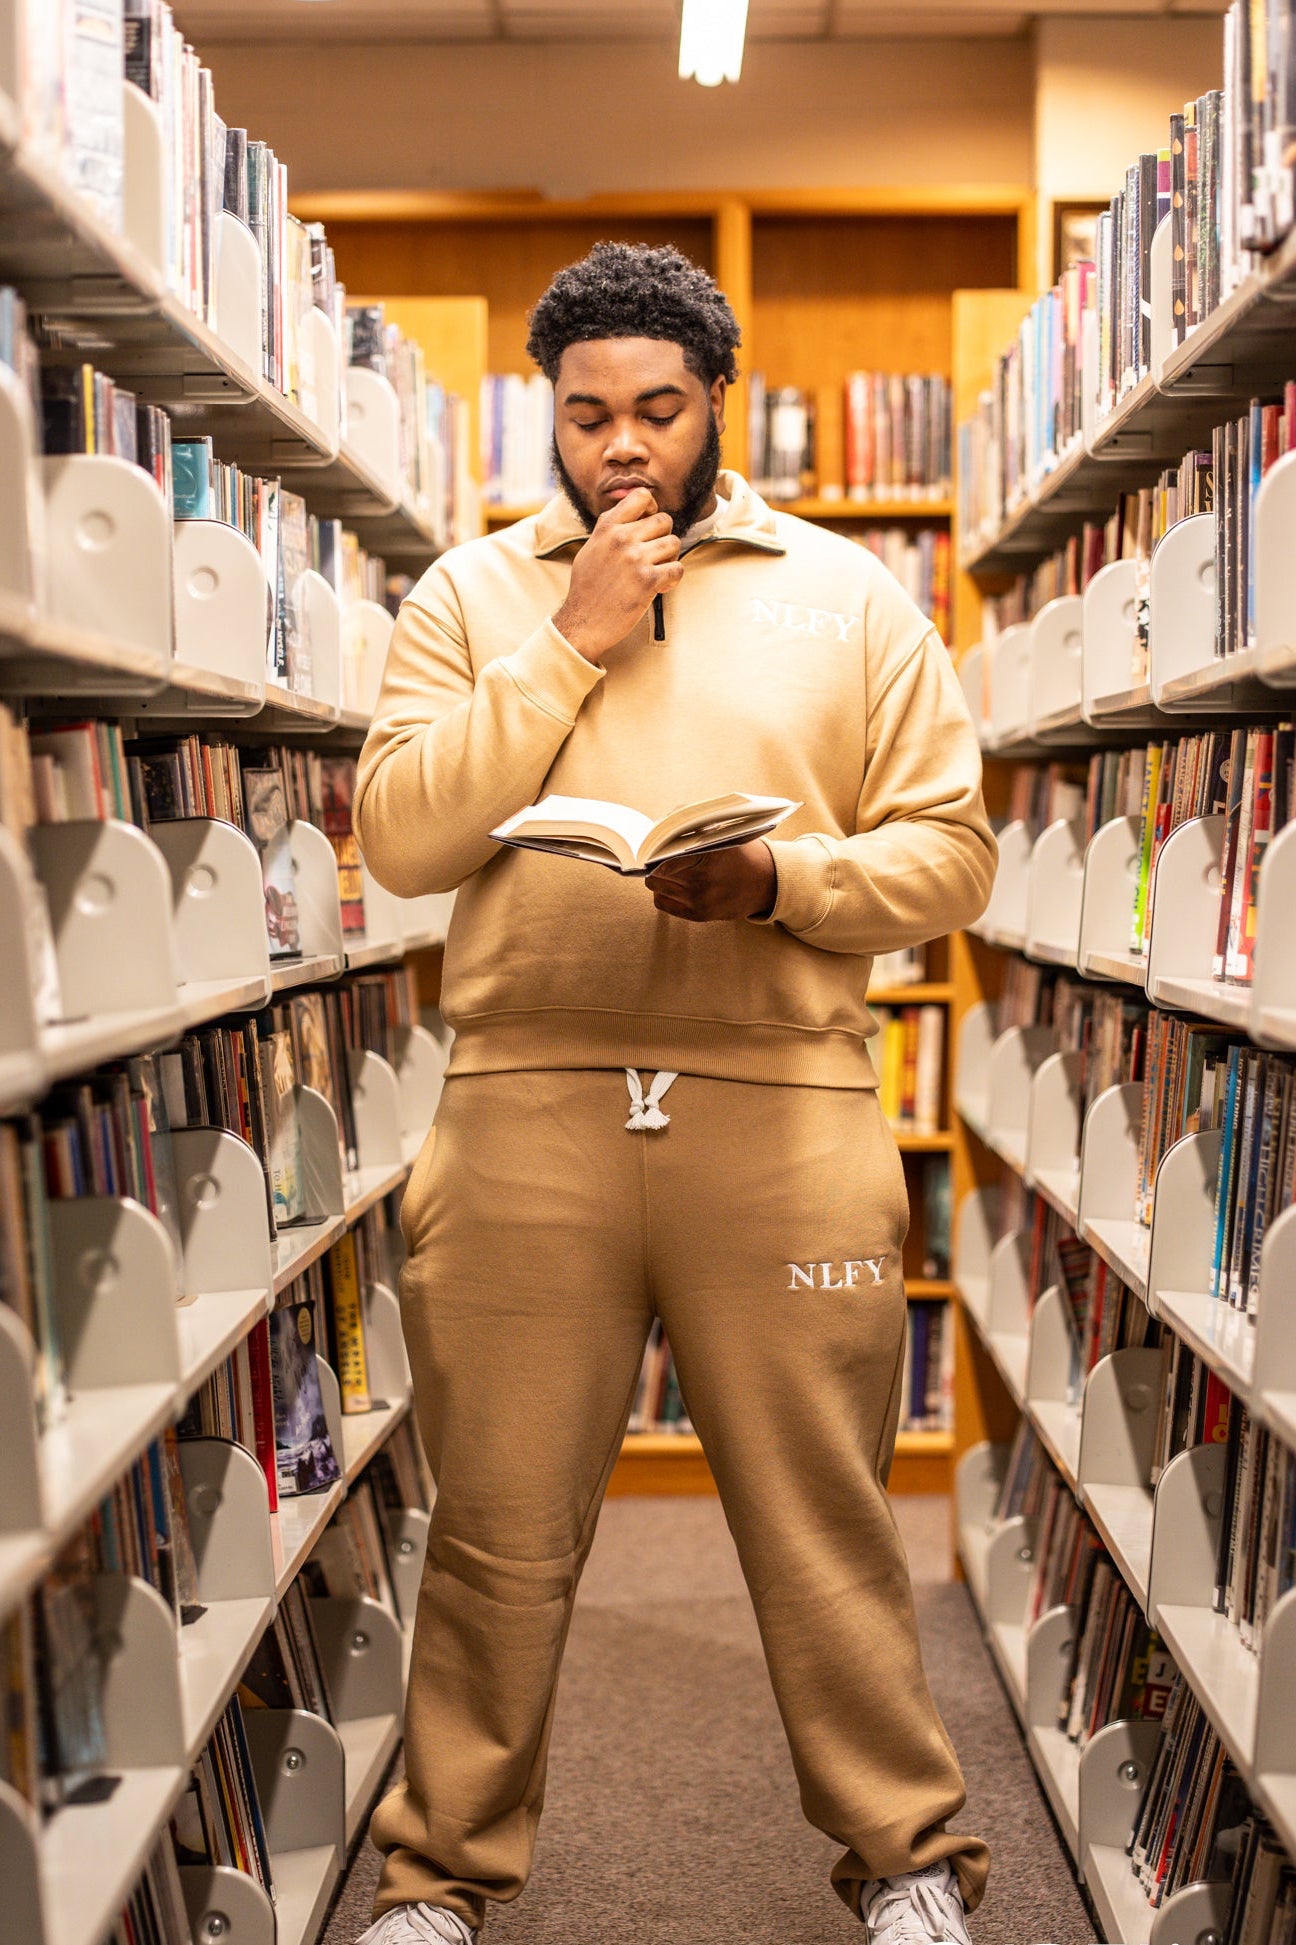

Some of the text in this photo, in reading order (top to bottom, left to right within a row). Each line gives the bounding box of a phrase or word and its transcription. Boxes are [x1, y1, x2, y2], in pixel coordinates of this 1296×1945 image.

[751, 598, 860, 643] NLFY
[1256, 1144, 1270, 1203] HIGH
[786, 1256, 885, 1289] NLFY
